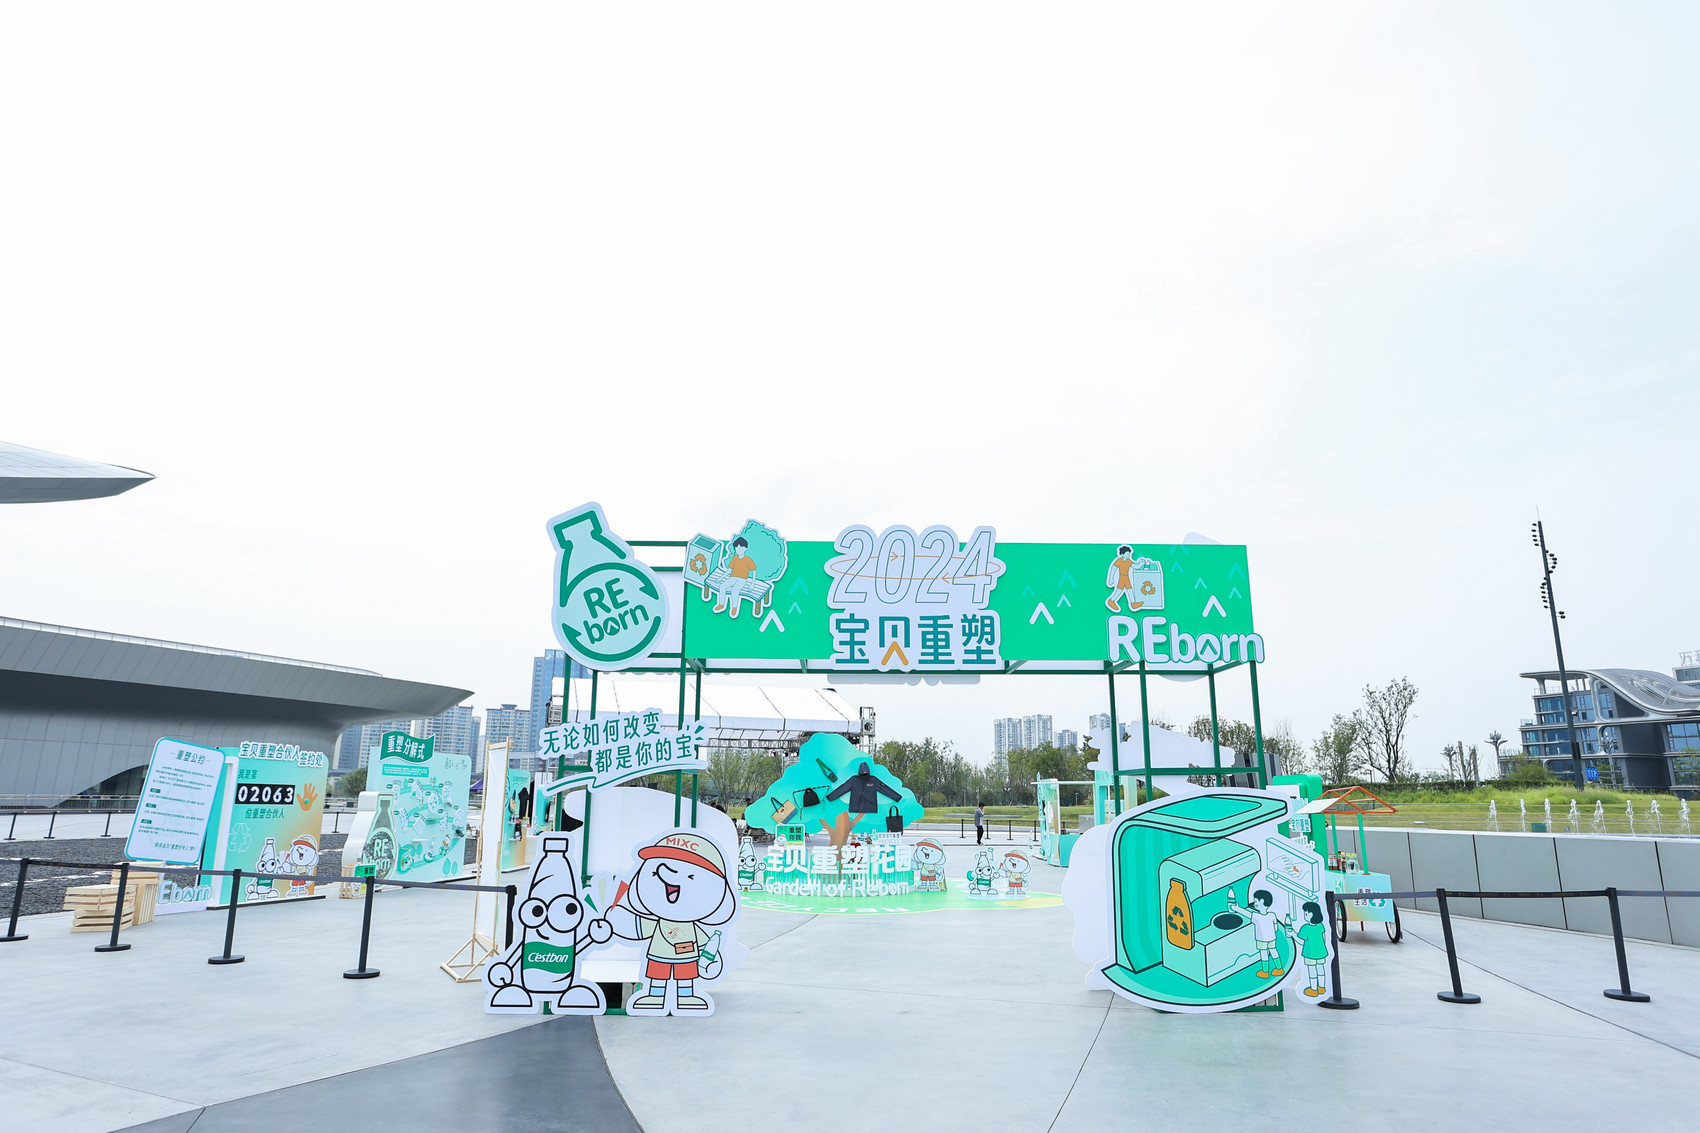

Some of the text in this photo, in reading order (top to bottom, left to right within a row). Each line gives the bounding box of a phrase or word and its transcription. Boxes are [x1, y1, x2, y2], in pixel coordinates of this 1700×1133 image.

[833, 530, 992, 604] 2024
[583, 577, 629, 619] RE
[583, 604, 649, 644] born
[835, 613, 997, 666] 宝贝重塑
[1107, 615, 1265, 663] REborn
[543, 711, 660, 755] 无论如何改变
[176, 749, 206, 765] 重塑公约
[240, 743, 323, 766] 宝贝重塑合伙人签约处
[387, 735, 425, 760] 重塑分解式
[595, 734, 692, 774] 都是你的宝
[237, 769, 258, 779] 我是第
[238, 786, 294, 803] 02063
[245, 808, 285, 819] 位重塑合伙人
[373, 838, 389, 858] RE
[666, 837, 699, 851] MIXC
[766, 844, 912, 875] 宝贝重塑花园
[158, 879, 212, 904] Eborn
[765, 876, 909, 897] Garden of Reborn
